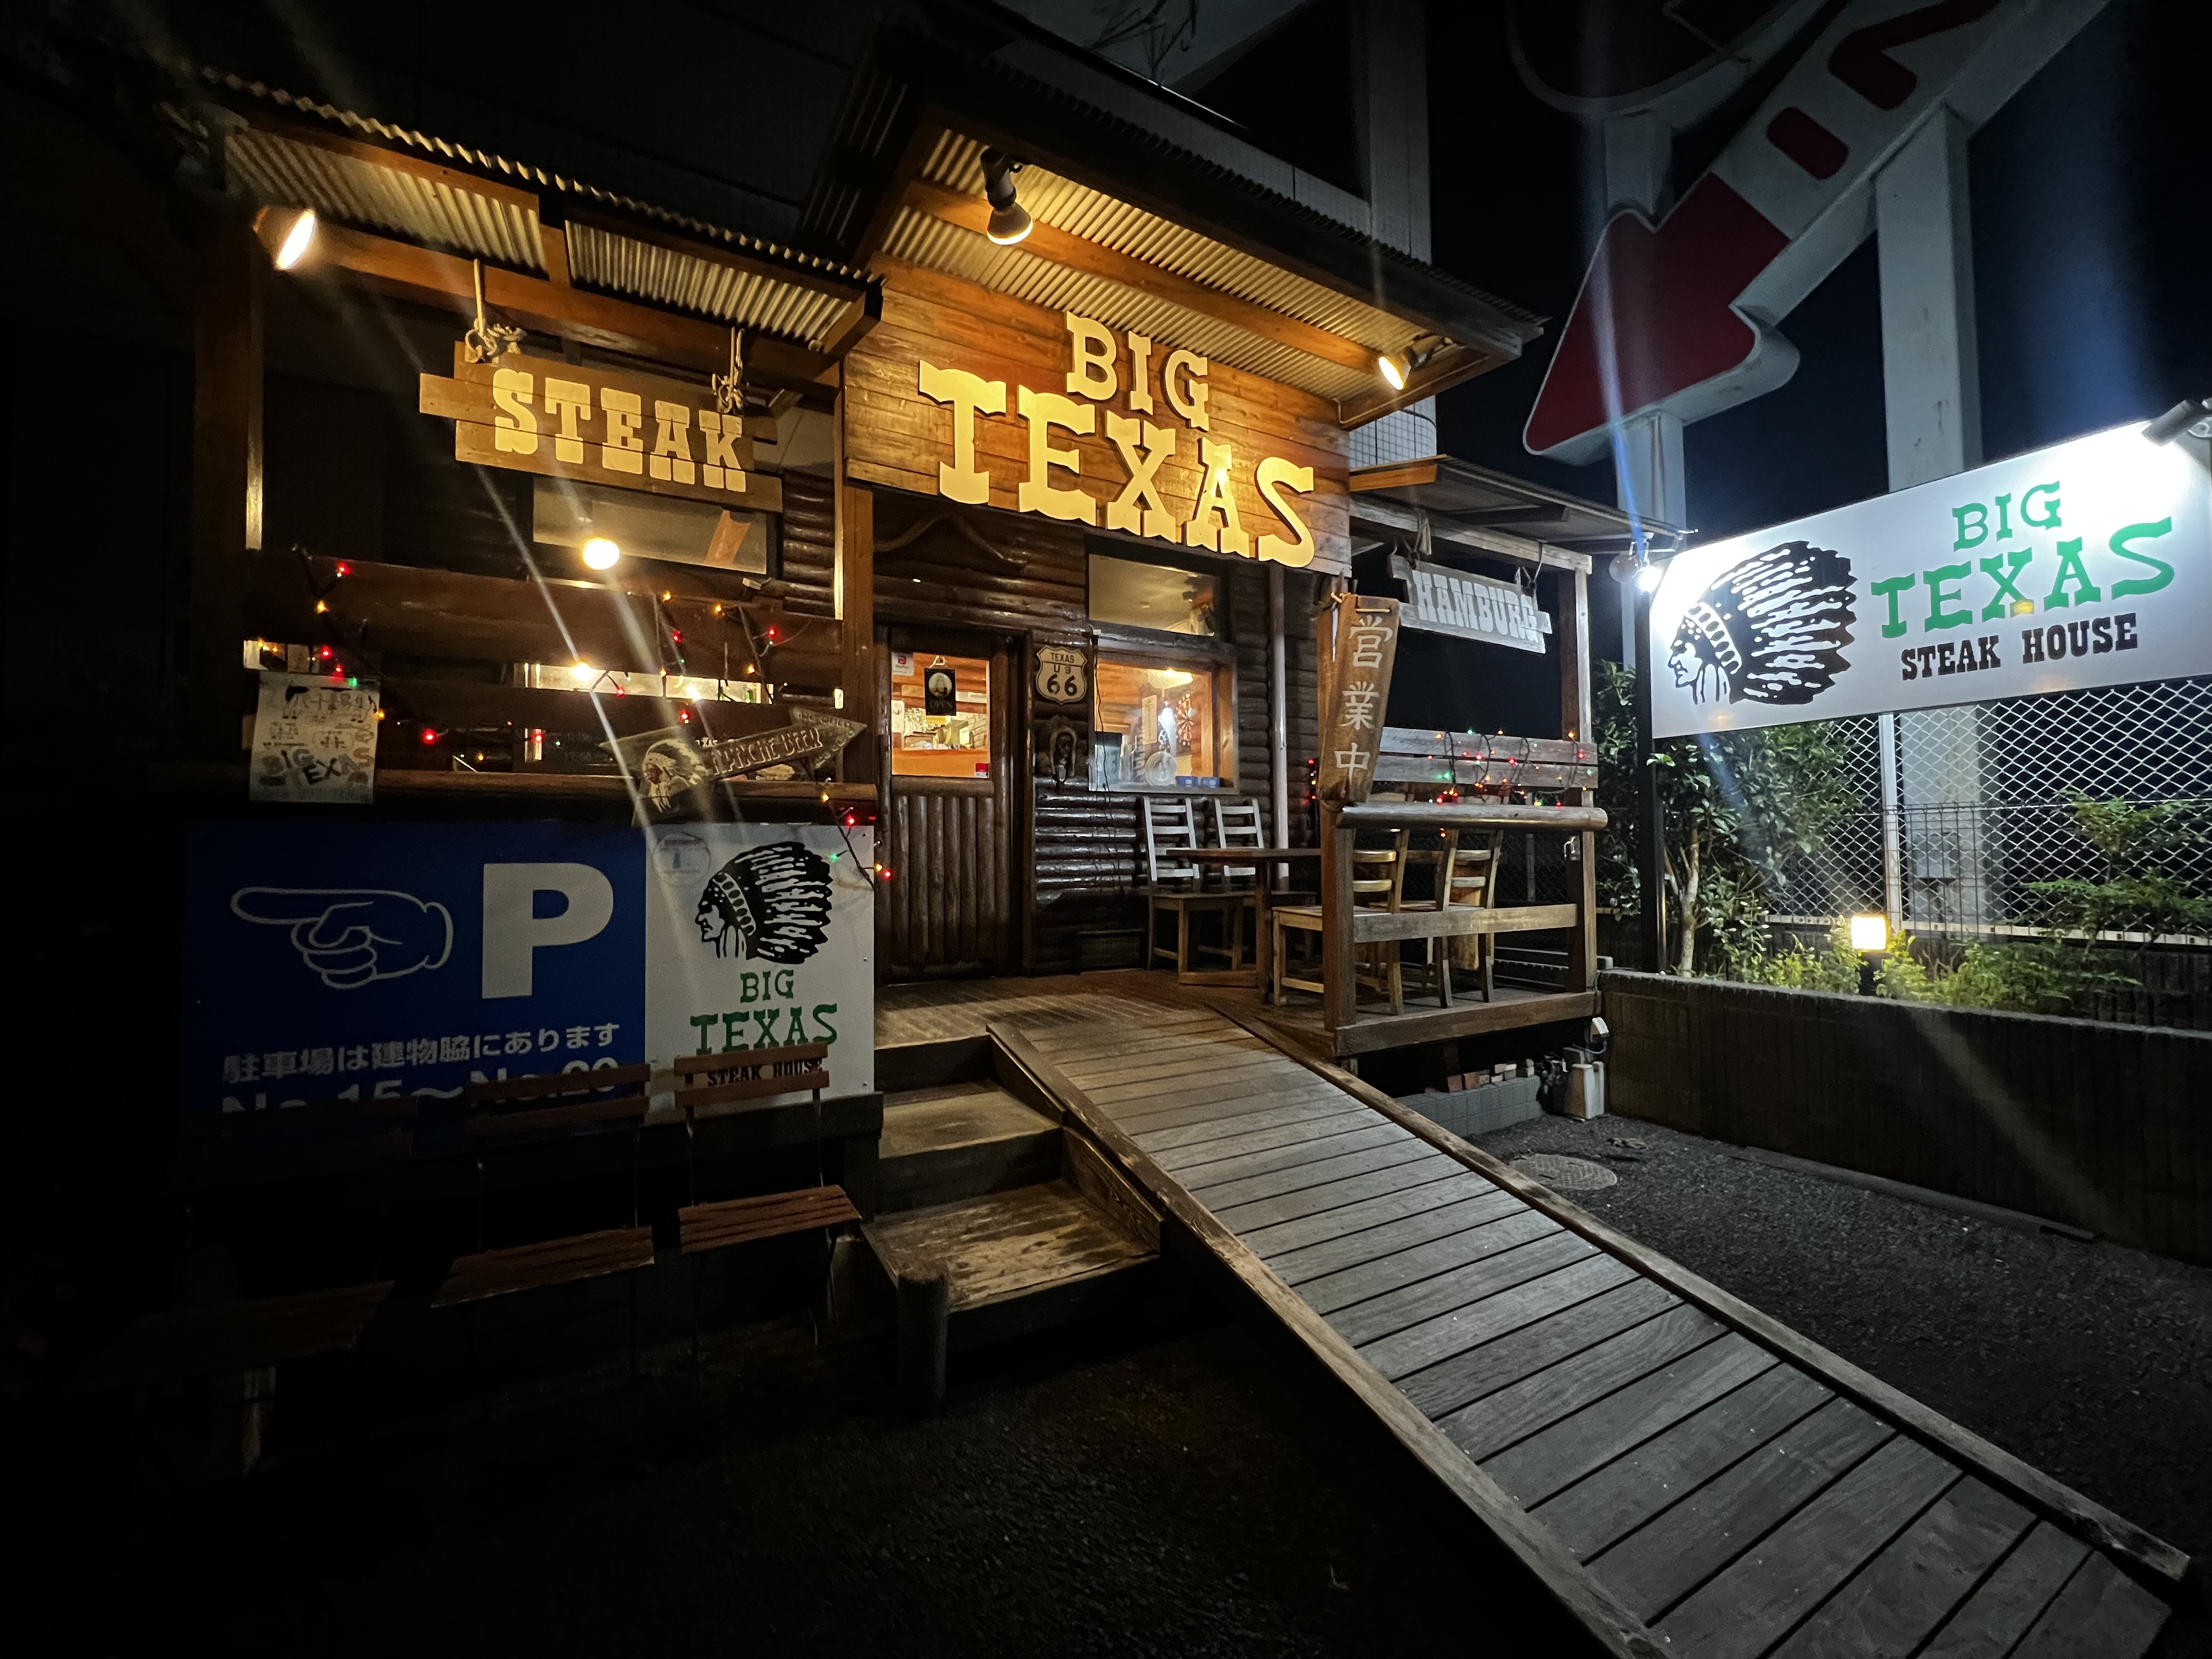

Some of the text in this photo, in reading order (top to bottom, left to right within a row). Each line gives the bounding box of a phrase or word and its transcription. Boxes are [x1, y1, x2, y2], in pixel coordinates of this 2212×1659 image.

[1064, 311, 1210, 431] BIG
[494, 368, 747, 493] STEAK
[918, 359, 1317, 568] TEXAS
[1952, 481, 2062, 552] BIG
[1412, 570, 1538, 643] HAMBURG
[1871, 517, 2175, 639] TEXAS
[1051, 652, 1074, 663] TEXAS
[1901, 612, 2137, 681] STEAK HOUSE
[1047, 674, 1077, 696] 66
[1334, 615, 1393, 782] 営業中
[481, 862, 614, 1000] P
[740, 969, 794, 1003] BIG
[222, 1023, 619, 1085] 駐車場は建物脇にあります
[690, 1003, 837, 1055] TEXAS
[708, 1064, 762, 1086] STEAK
